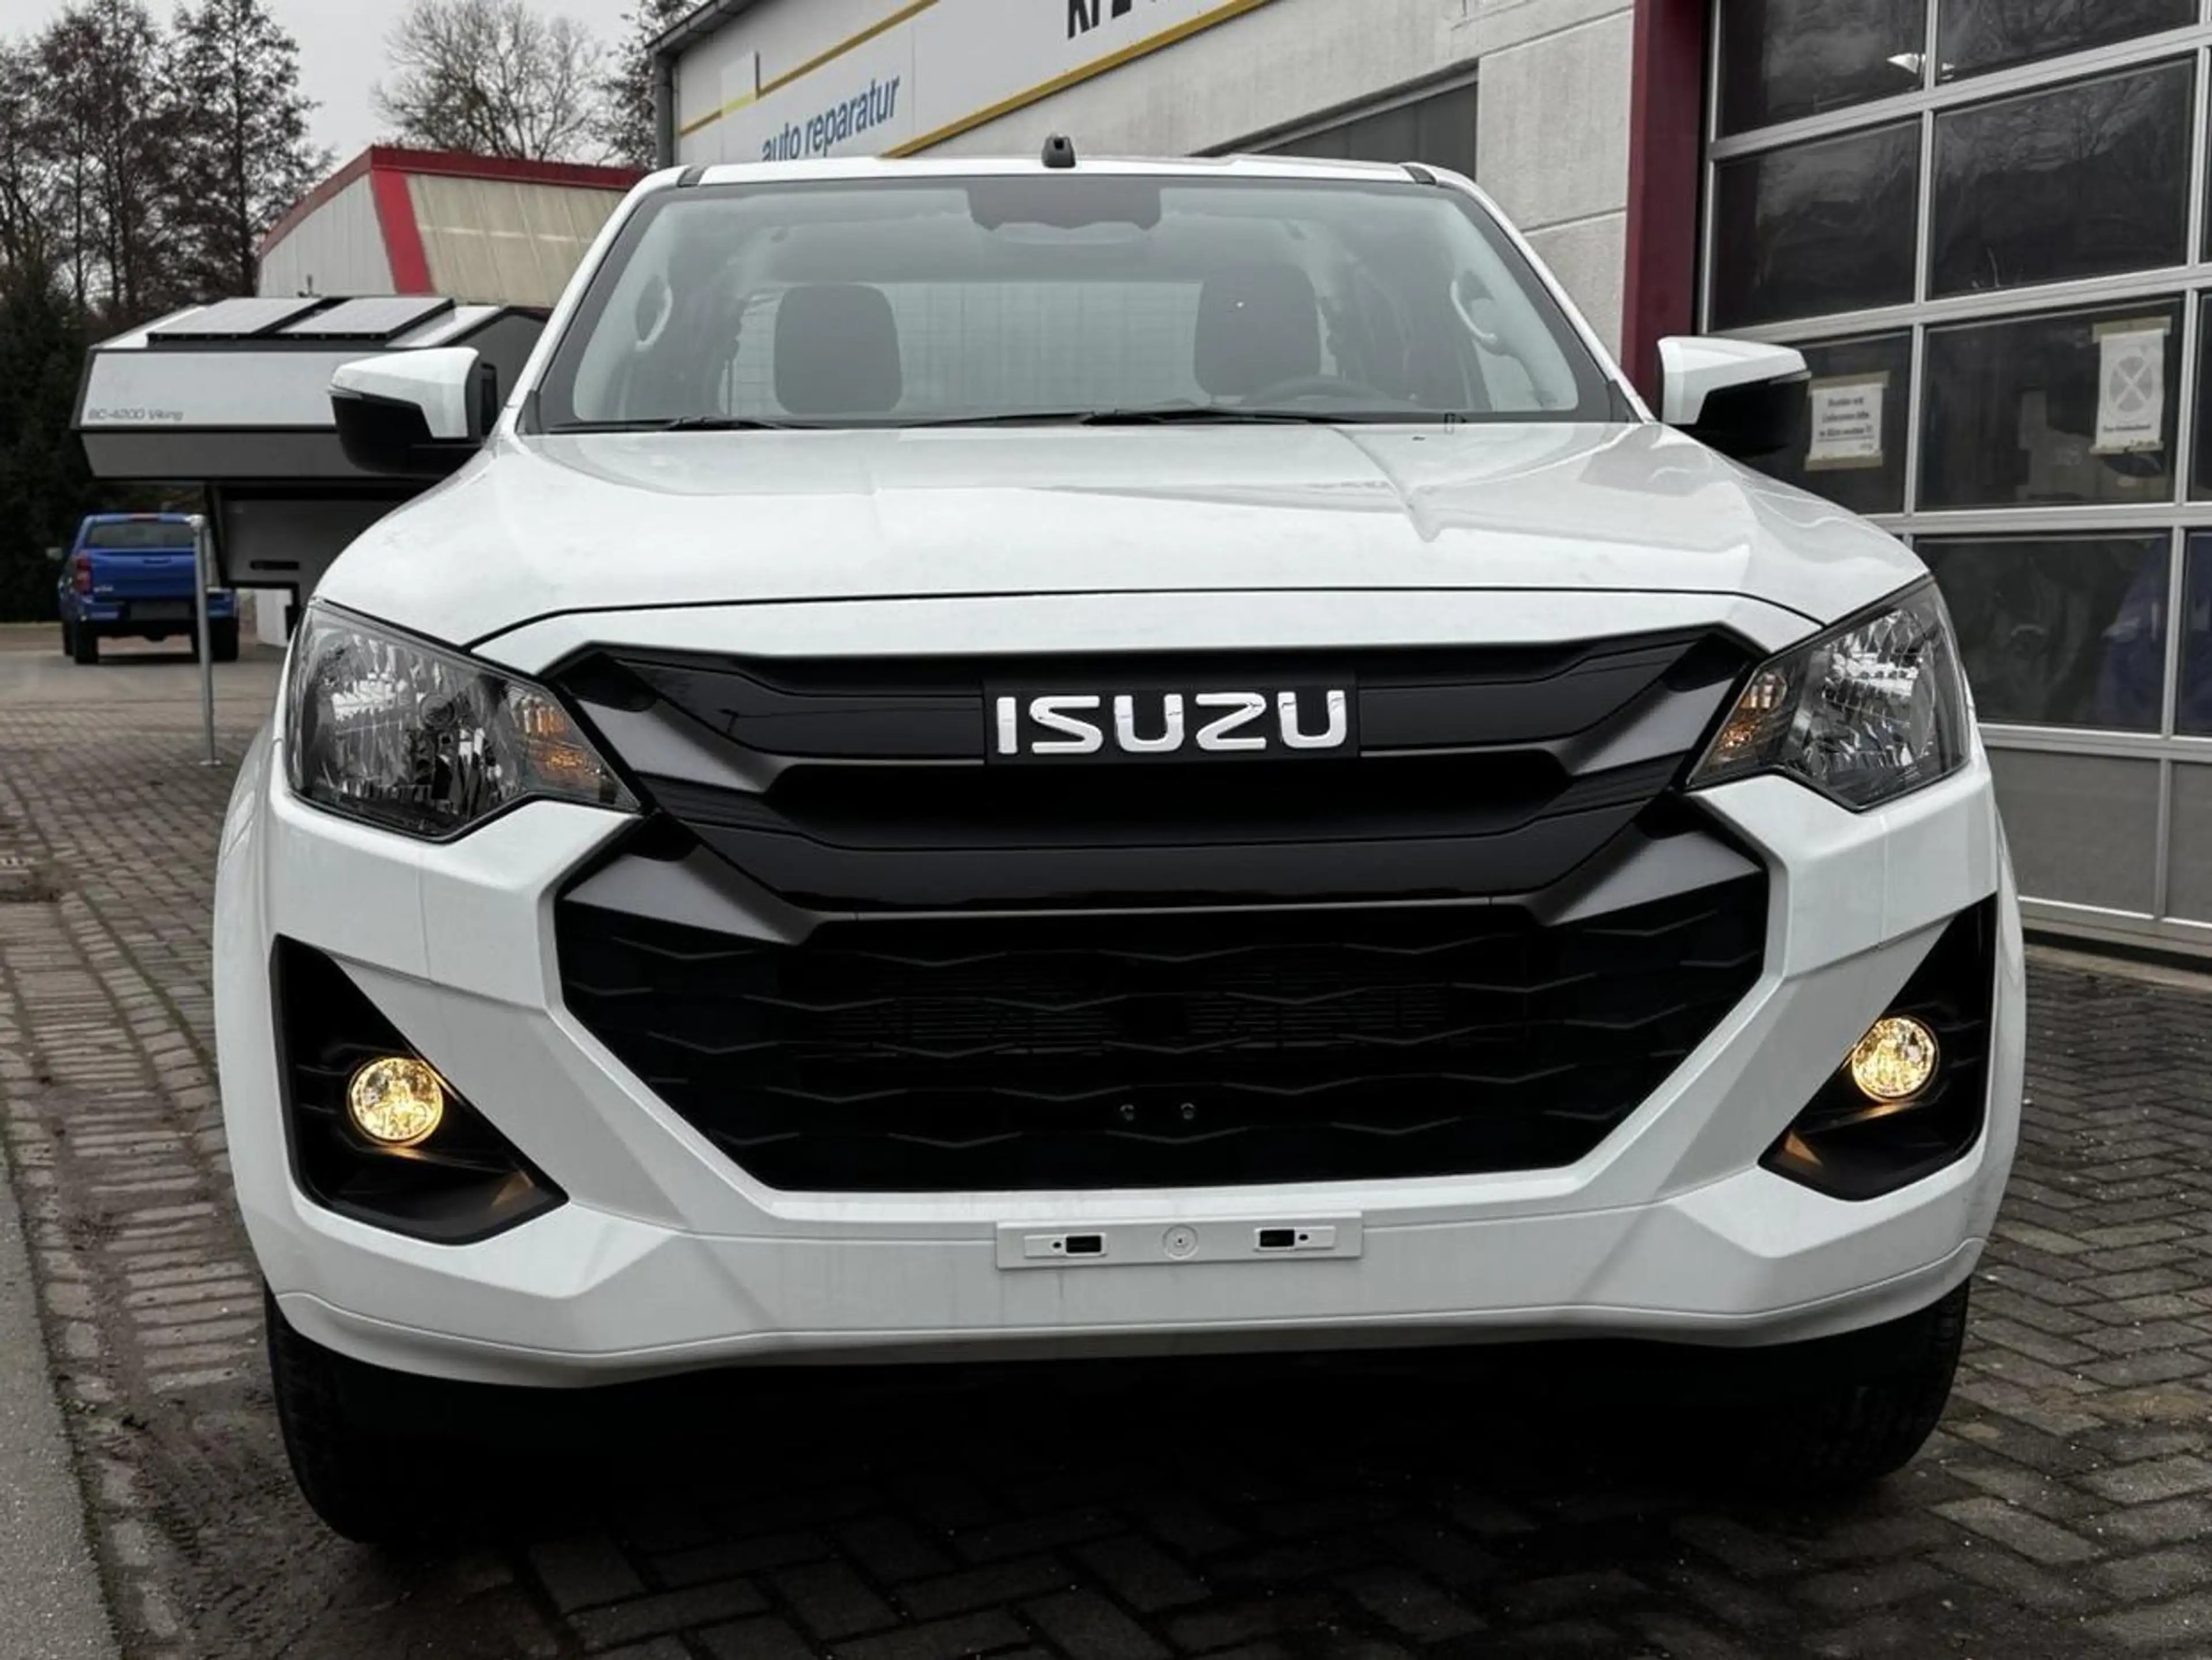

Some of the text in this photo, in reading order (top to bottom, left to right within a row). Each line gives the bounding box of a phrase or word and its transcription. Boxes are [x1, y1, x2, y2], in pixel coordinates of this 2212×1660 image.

[762, 76, 900, 161] auto reparatur
[996, 690, 1347, 754] ISUZU
